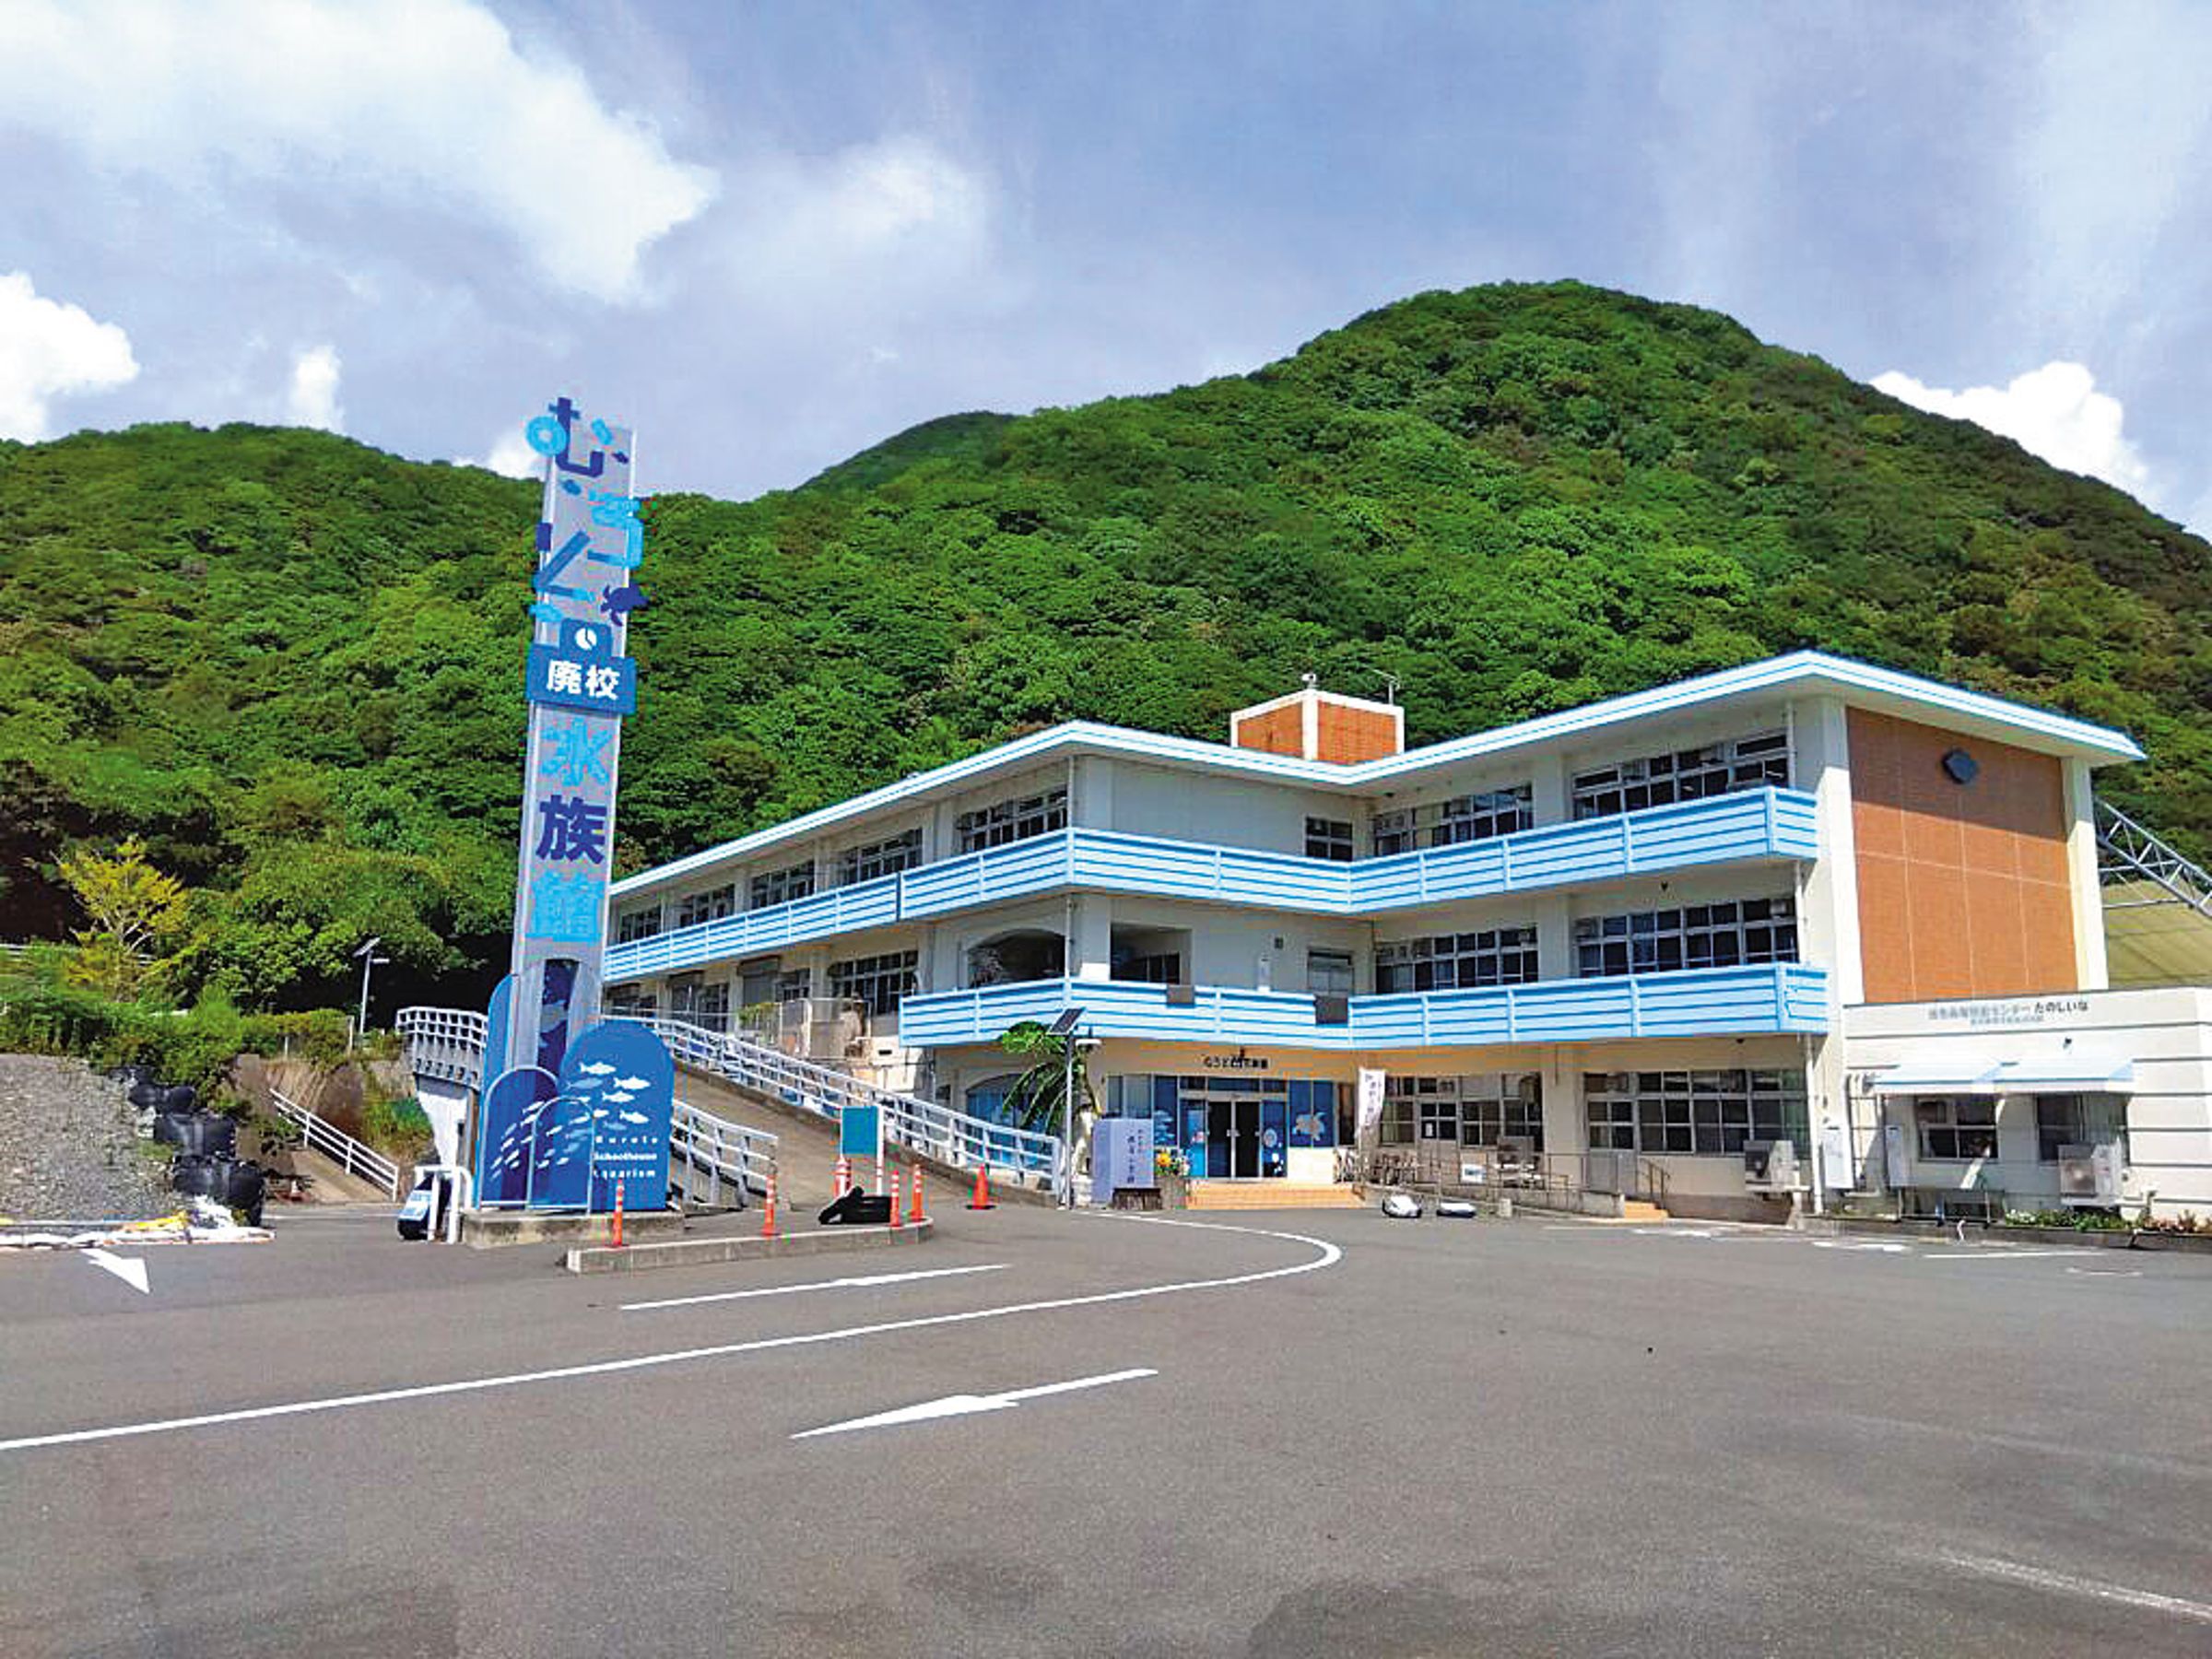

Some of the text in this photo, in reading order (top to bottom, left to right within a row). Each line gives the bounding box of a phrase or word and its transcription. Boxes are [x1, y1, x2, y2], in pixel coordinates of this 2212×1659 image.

[547, 658, 620, 700] 廃校
[525, 716, 617, 943] 水族館
